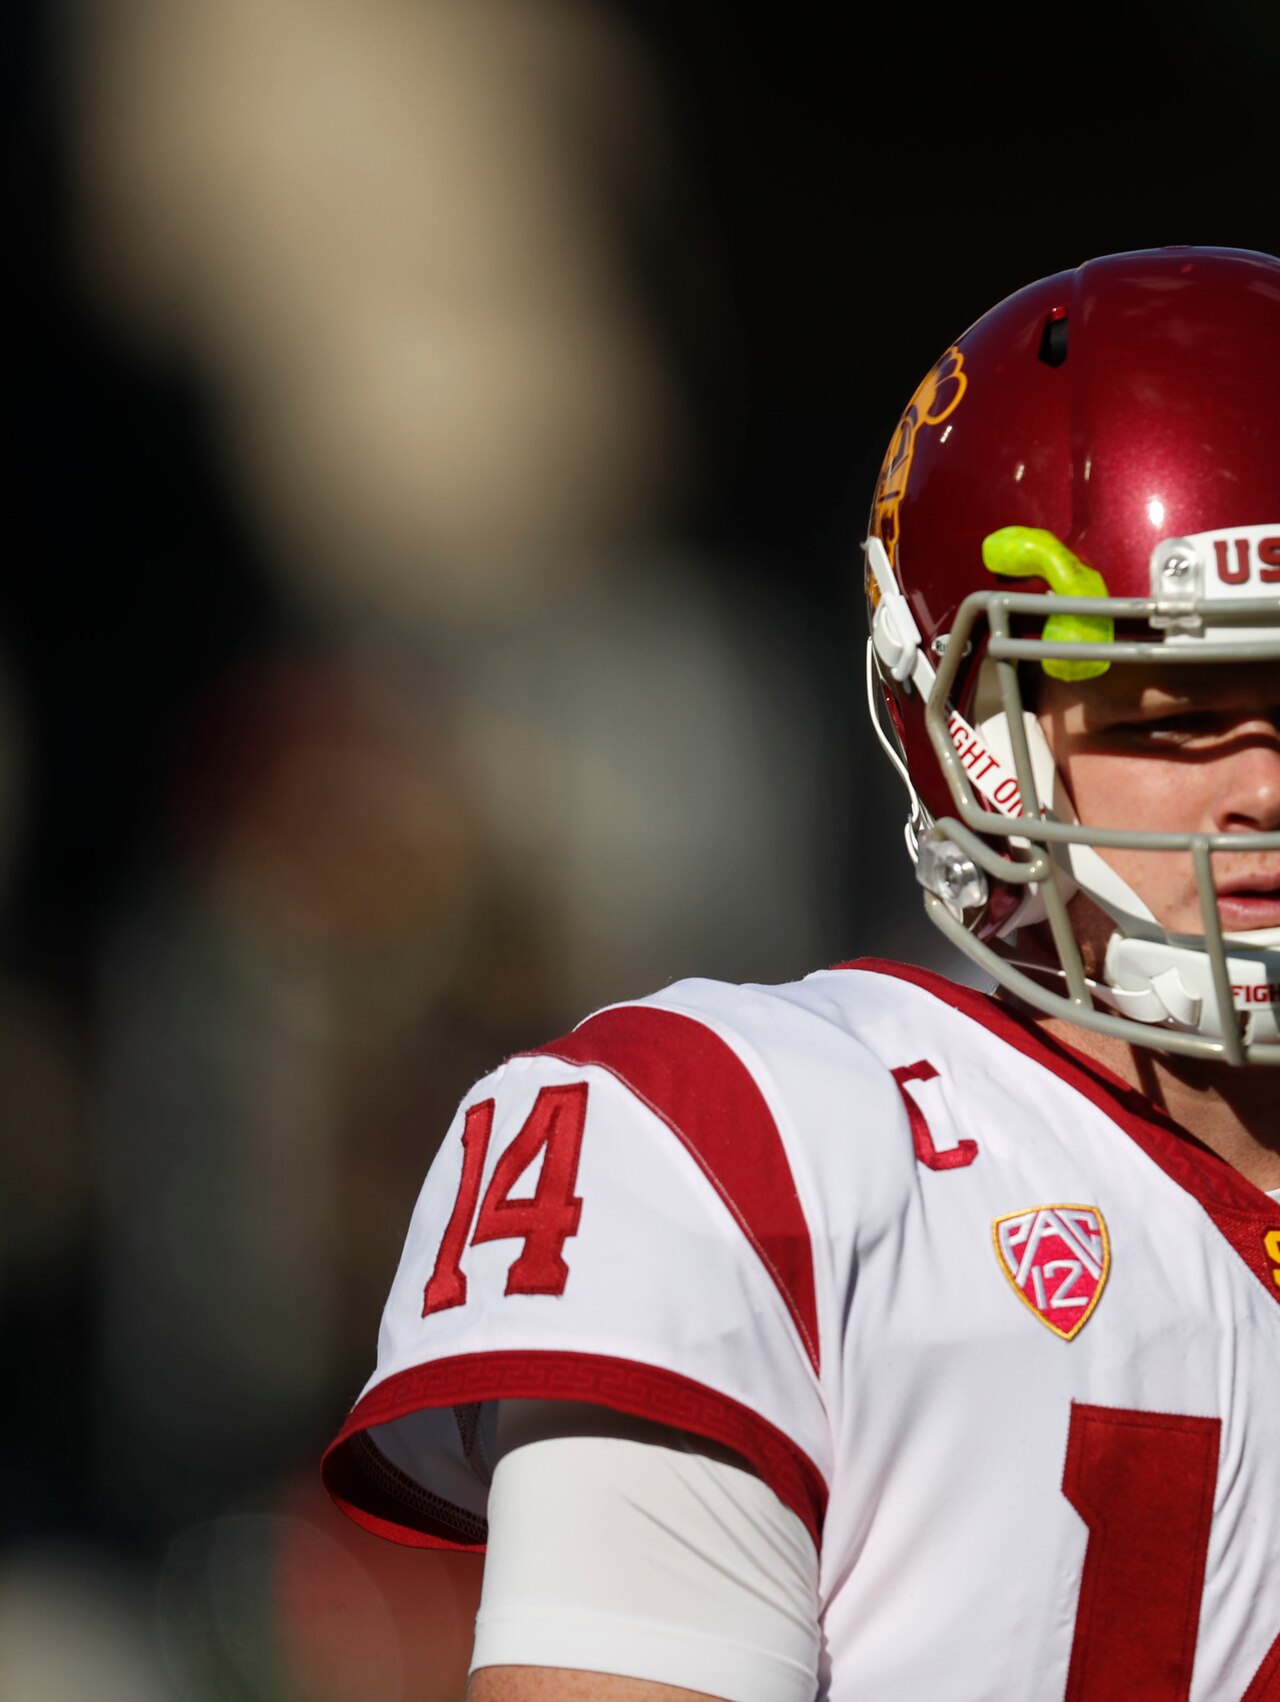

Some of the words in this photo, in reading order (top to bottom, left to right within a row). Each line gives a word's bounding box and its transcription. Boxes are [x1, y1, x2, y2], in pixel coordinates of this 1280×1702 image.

[889, 1058, 979, 1172] C
[421, 1081, 589, 1319] 14
[998, 1209, 1104, 1288] PAC
[1031, 1259, 1089, 1310] 12
